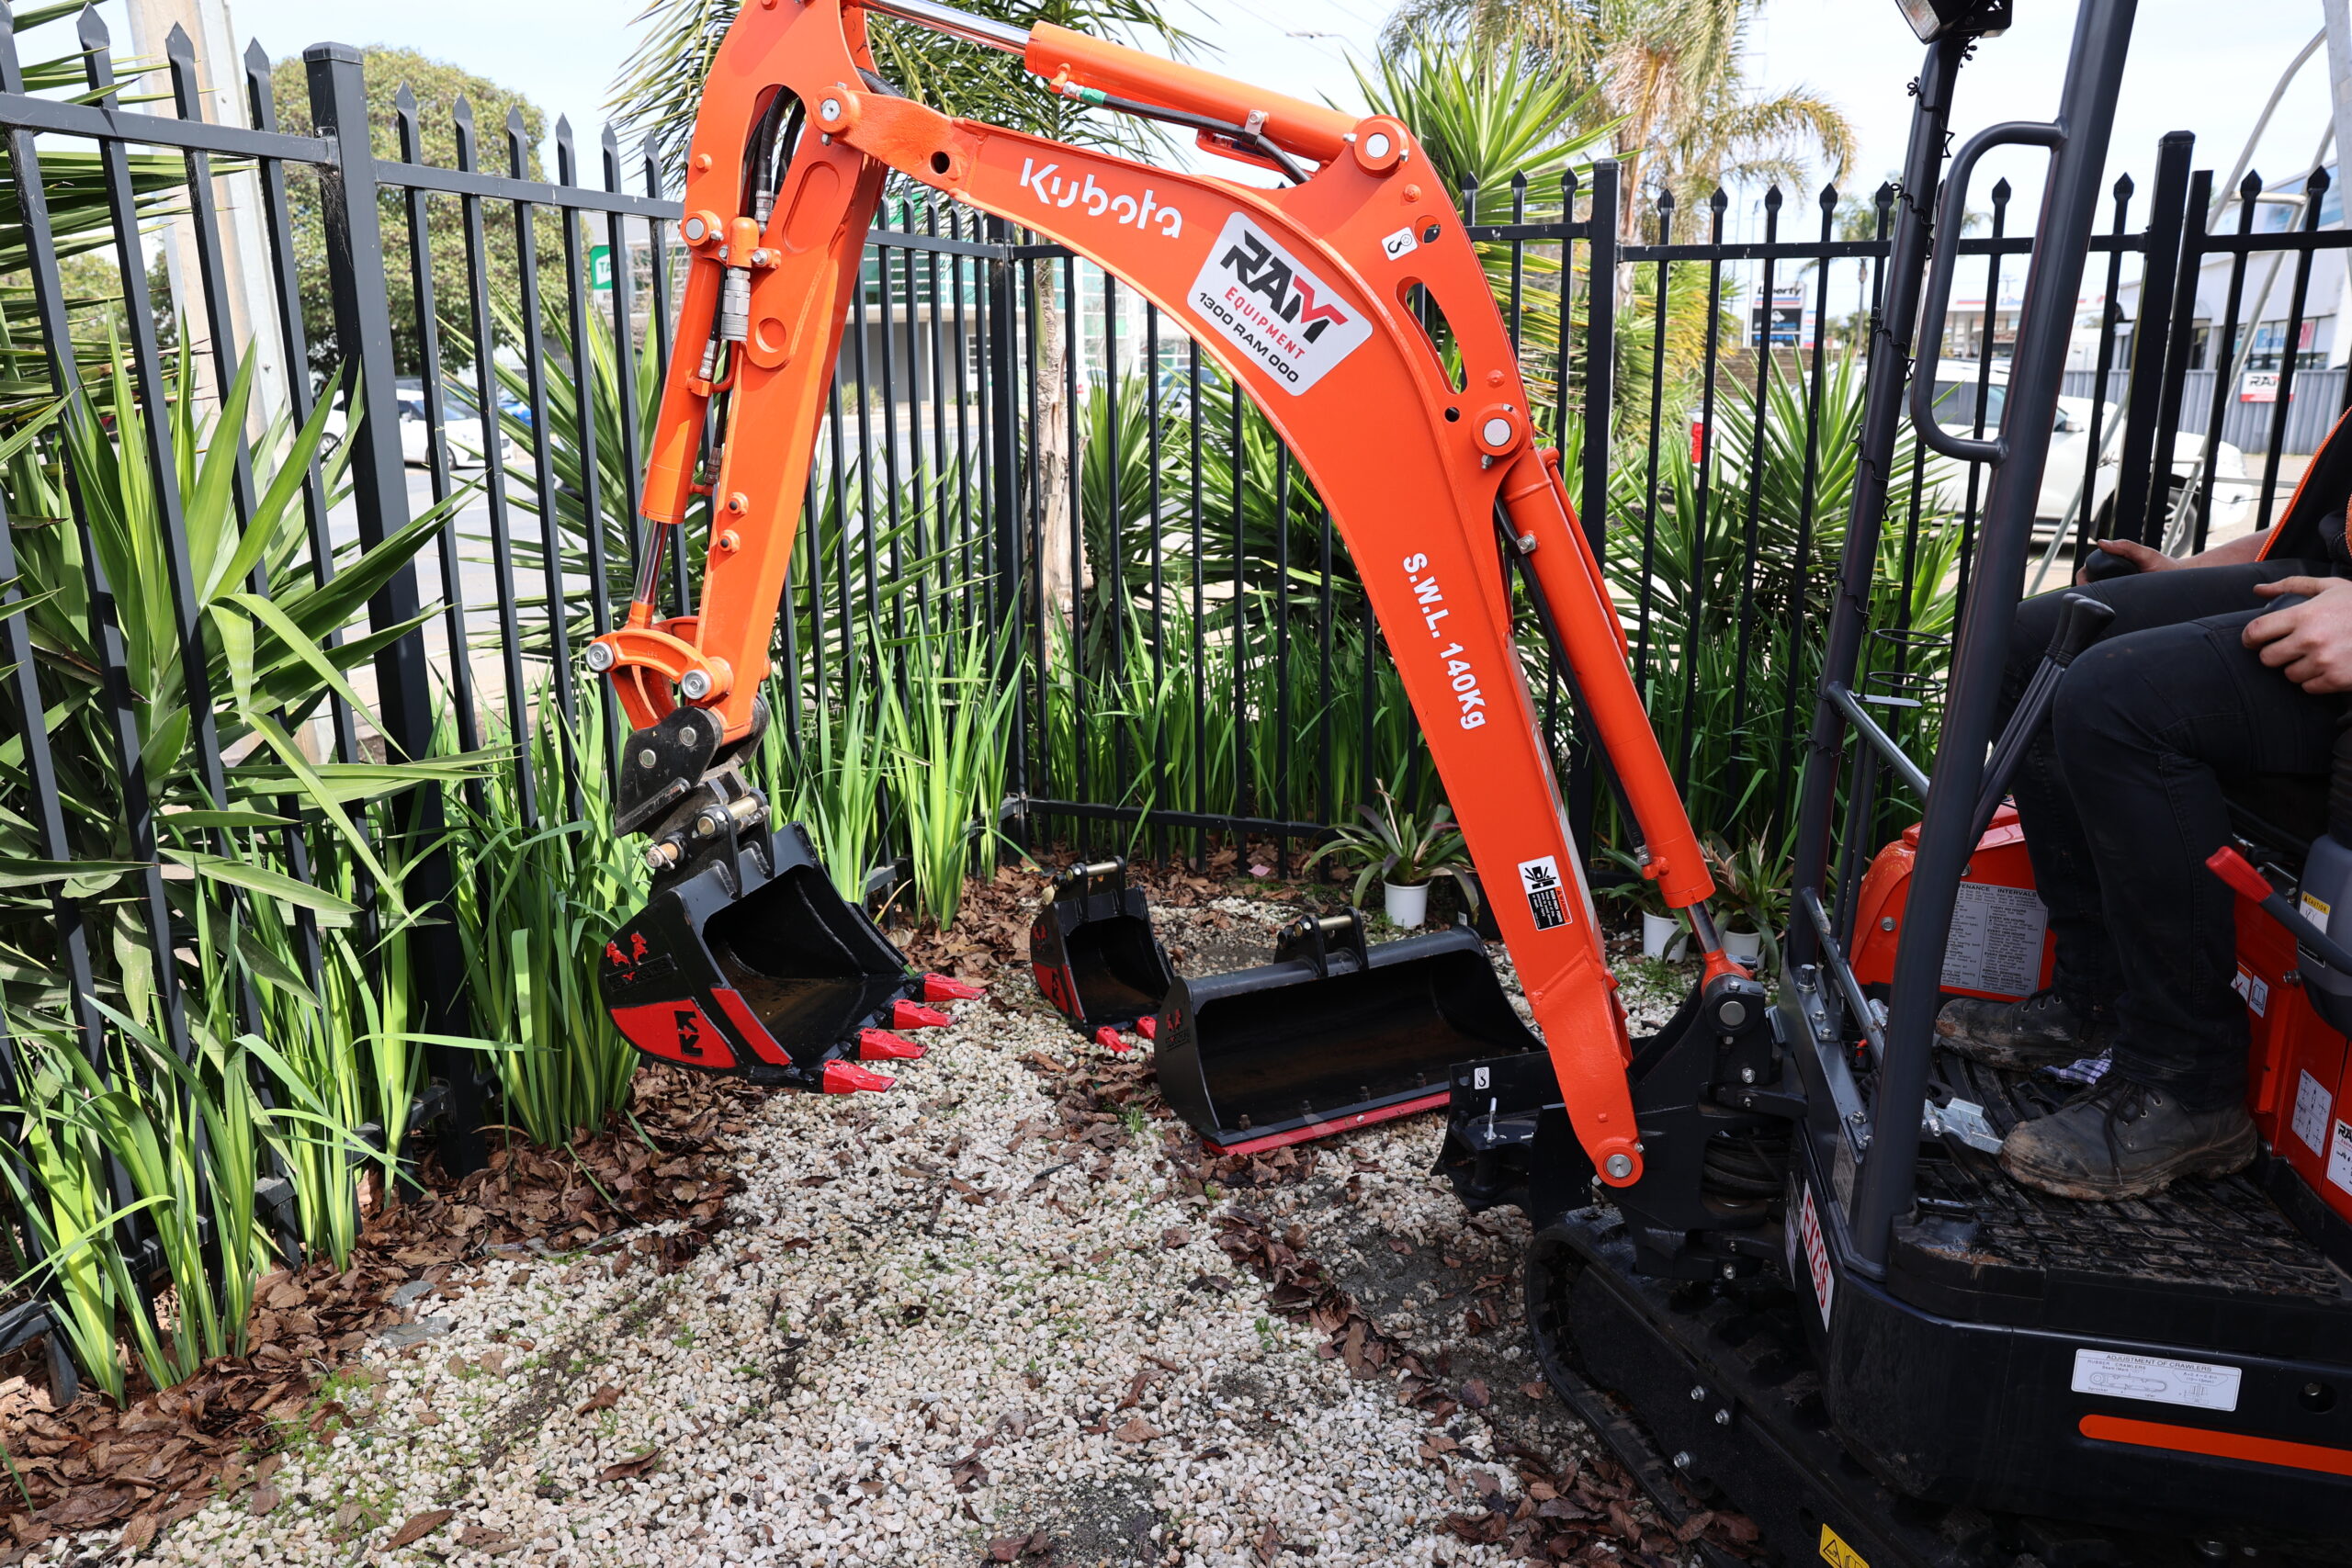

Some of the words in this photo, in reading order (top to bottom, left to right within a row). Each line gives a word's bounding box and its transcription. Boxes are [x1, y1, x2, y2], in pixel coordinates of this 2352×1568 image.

[1020, 157, 1183, 239] Kubota
[1219, 230, 1349, 344] RAM
[1224, 286, 1306, 359] EQUIPMENT
[1758, 287, 1802, 298] Lerty
[1200, 292, 1234, 325] 1300
[1233, 322, 1269, 356] RAM
[1268, 354, 1299, 383] 000
[1403, 552, 1449, 638] S.W.L.
[1440, 642, 1487, 730] 140Kg
[1997, 888, 2037, 897] INTERVALS
[2338, 1123, 2352, 1143] RA
[1804, 1193, 1828, 1309] EX236
[2107, 1355, 2154, 1365] ADJUSTMENT
[2169, 1362, 2212, 1372] CRAWLERS
